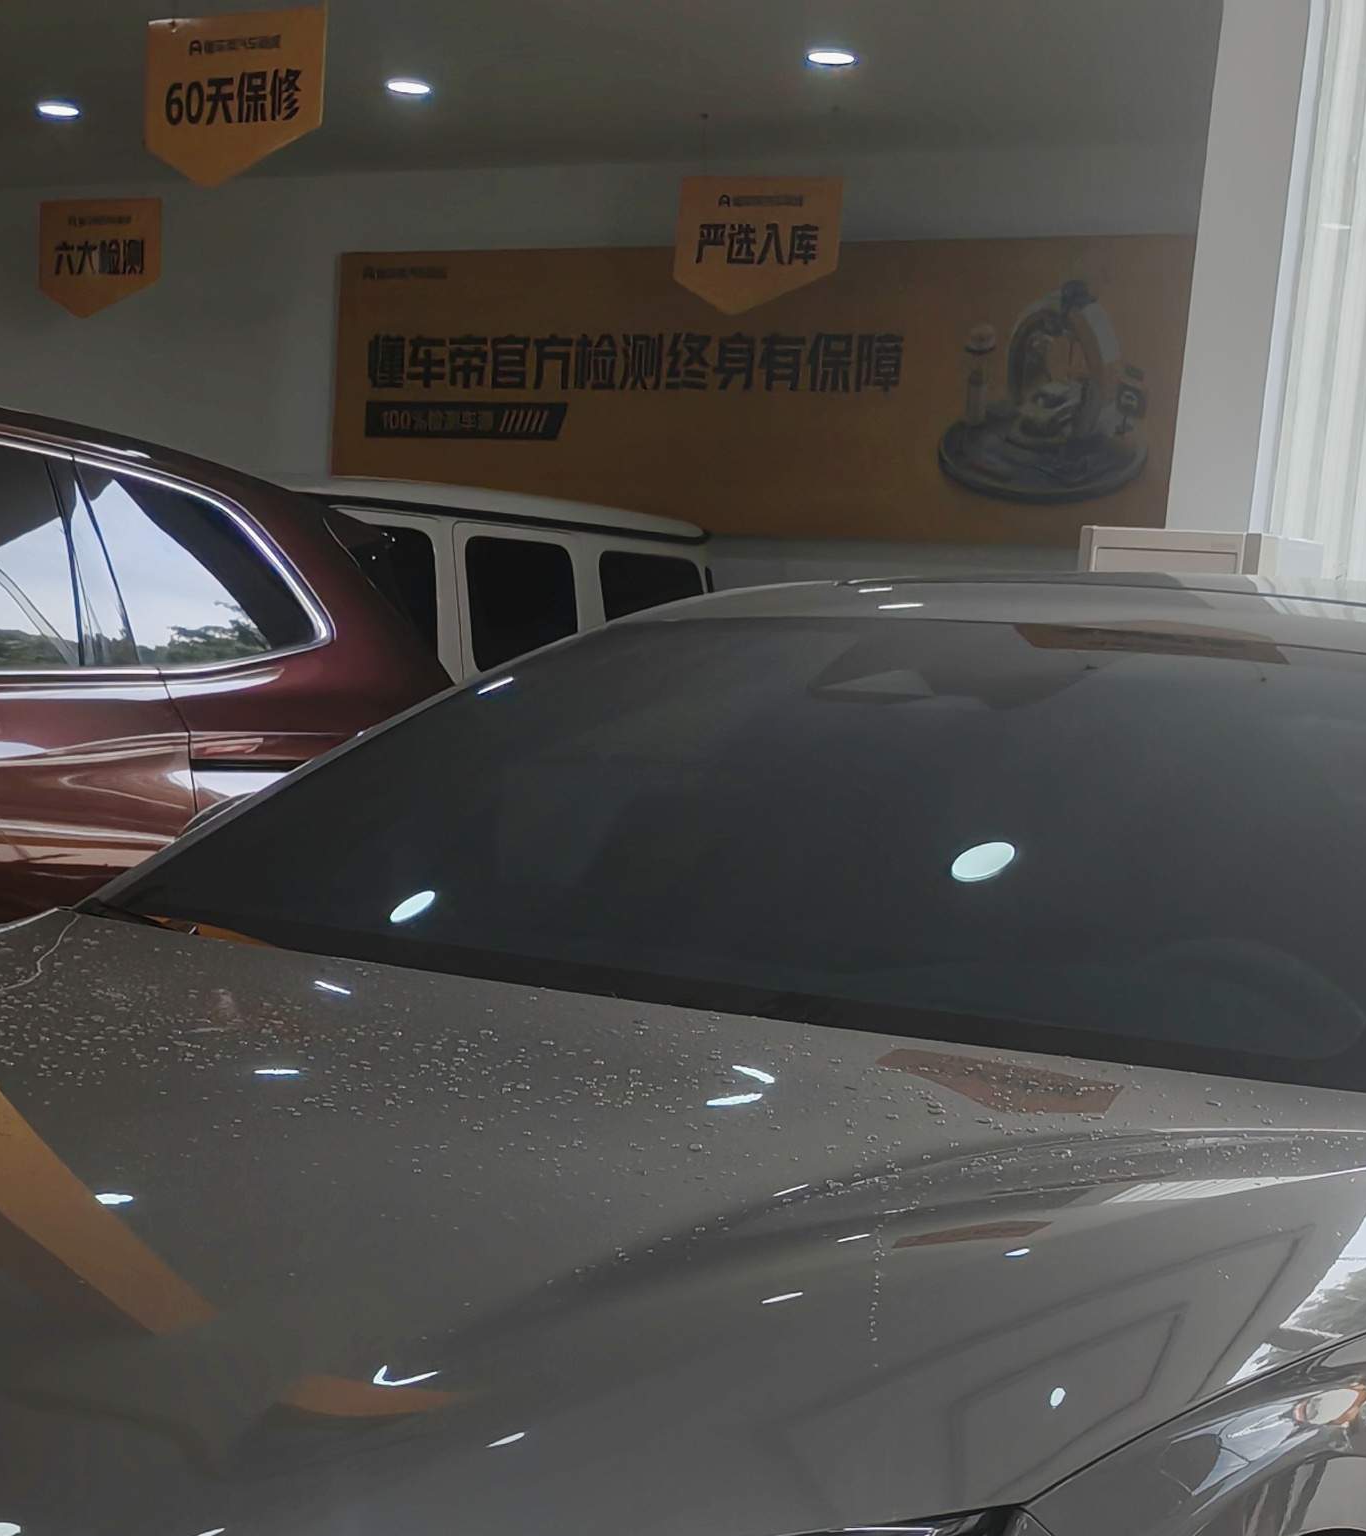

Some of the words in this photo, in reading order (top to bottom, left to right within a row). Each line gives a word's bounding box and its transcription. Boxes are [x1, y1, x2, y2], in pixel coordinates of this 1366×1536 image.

[165, 68, 303, 126] 60天保修
[54, 239, 145, 277] 六大检测
[695, 222, 819, 265] 严选入库
[367, 334, 905, 393] 懂车帝官方检测终身有保障
